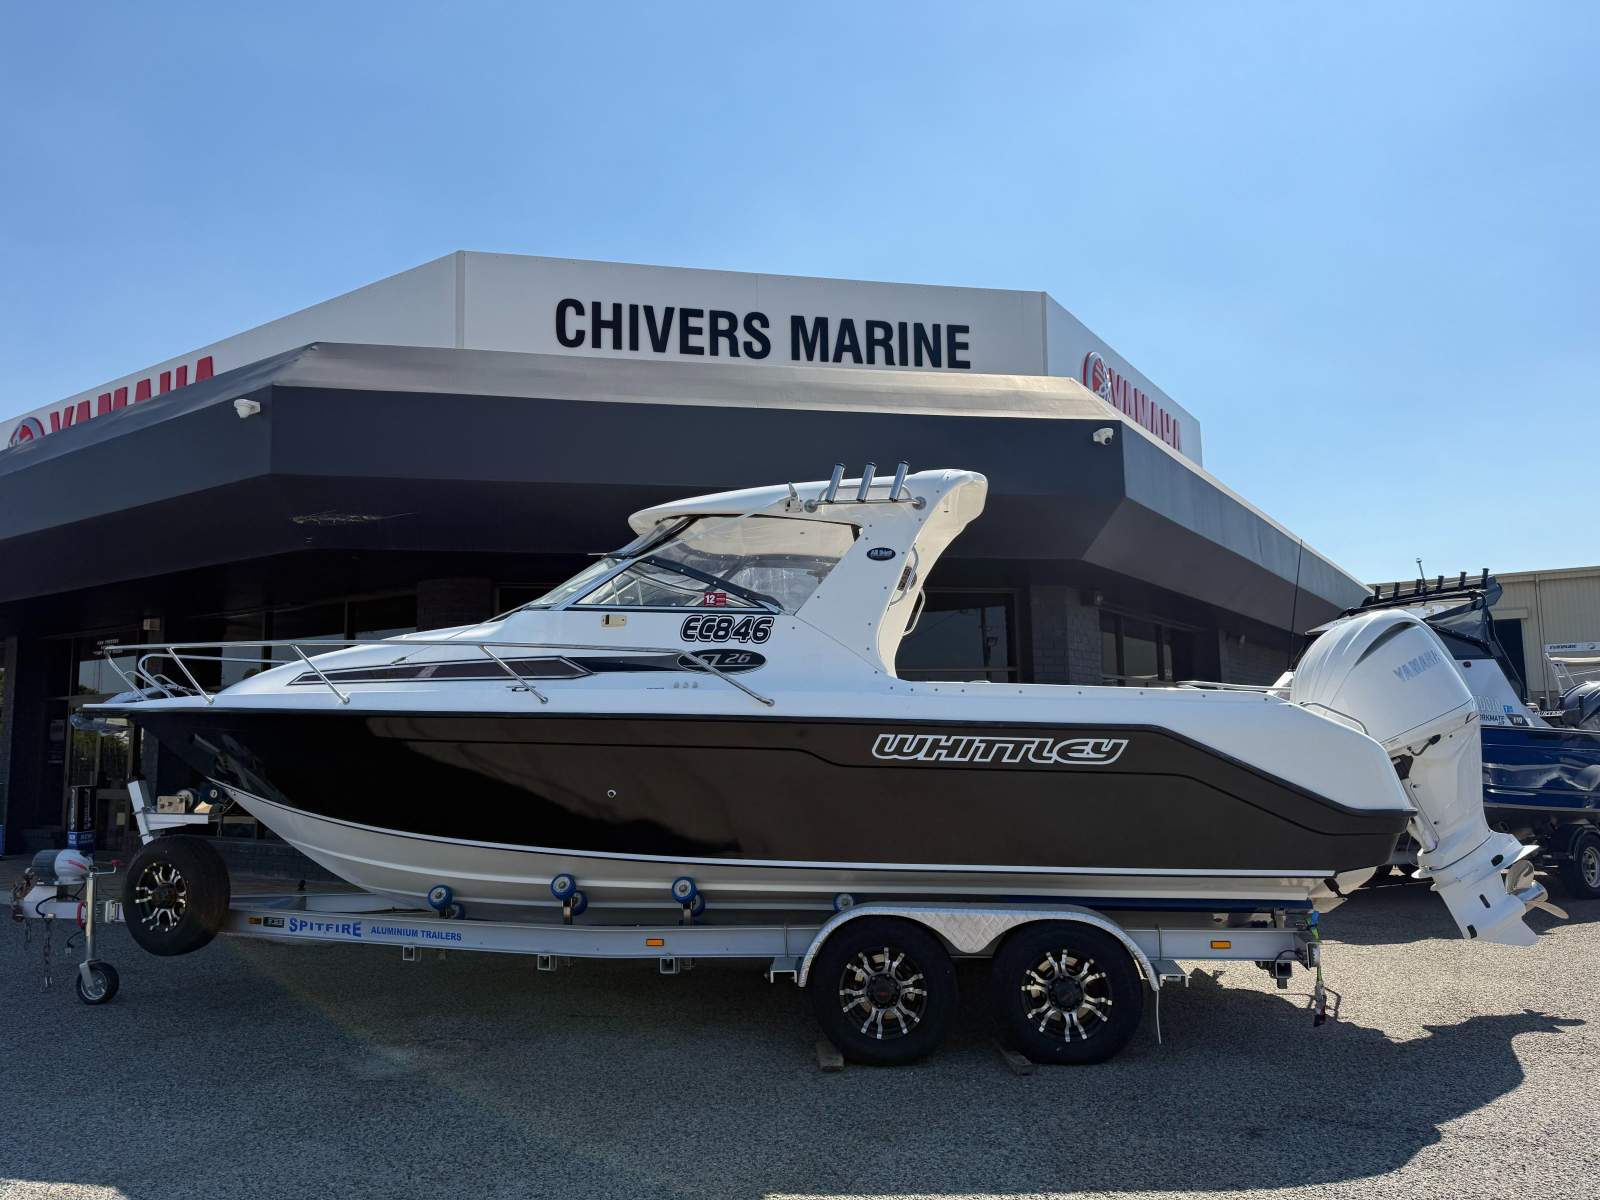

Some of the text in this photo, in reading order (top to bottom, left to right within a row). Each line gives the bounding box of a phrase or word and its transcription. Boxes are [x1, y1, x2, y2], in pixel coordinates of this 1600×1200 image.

[555, 298, 971, 369] CHIVERS MARINE
[705, 594, 716, 604] 12
[680, 615, 774, 644] EC846
[724, 653, 751, 664] 26
[871, 733, 1129, 765] WHITTLEY
[288, 916, 363, 938] SPITFIRE
[370, 925, 419, 938] ALUMINIUM
[420, 929, 462, 942] TRAILERS
